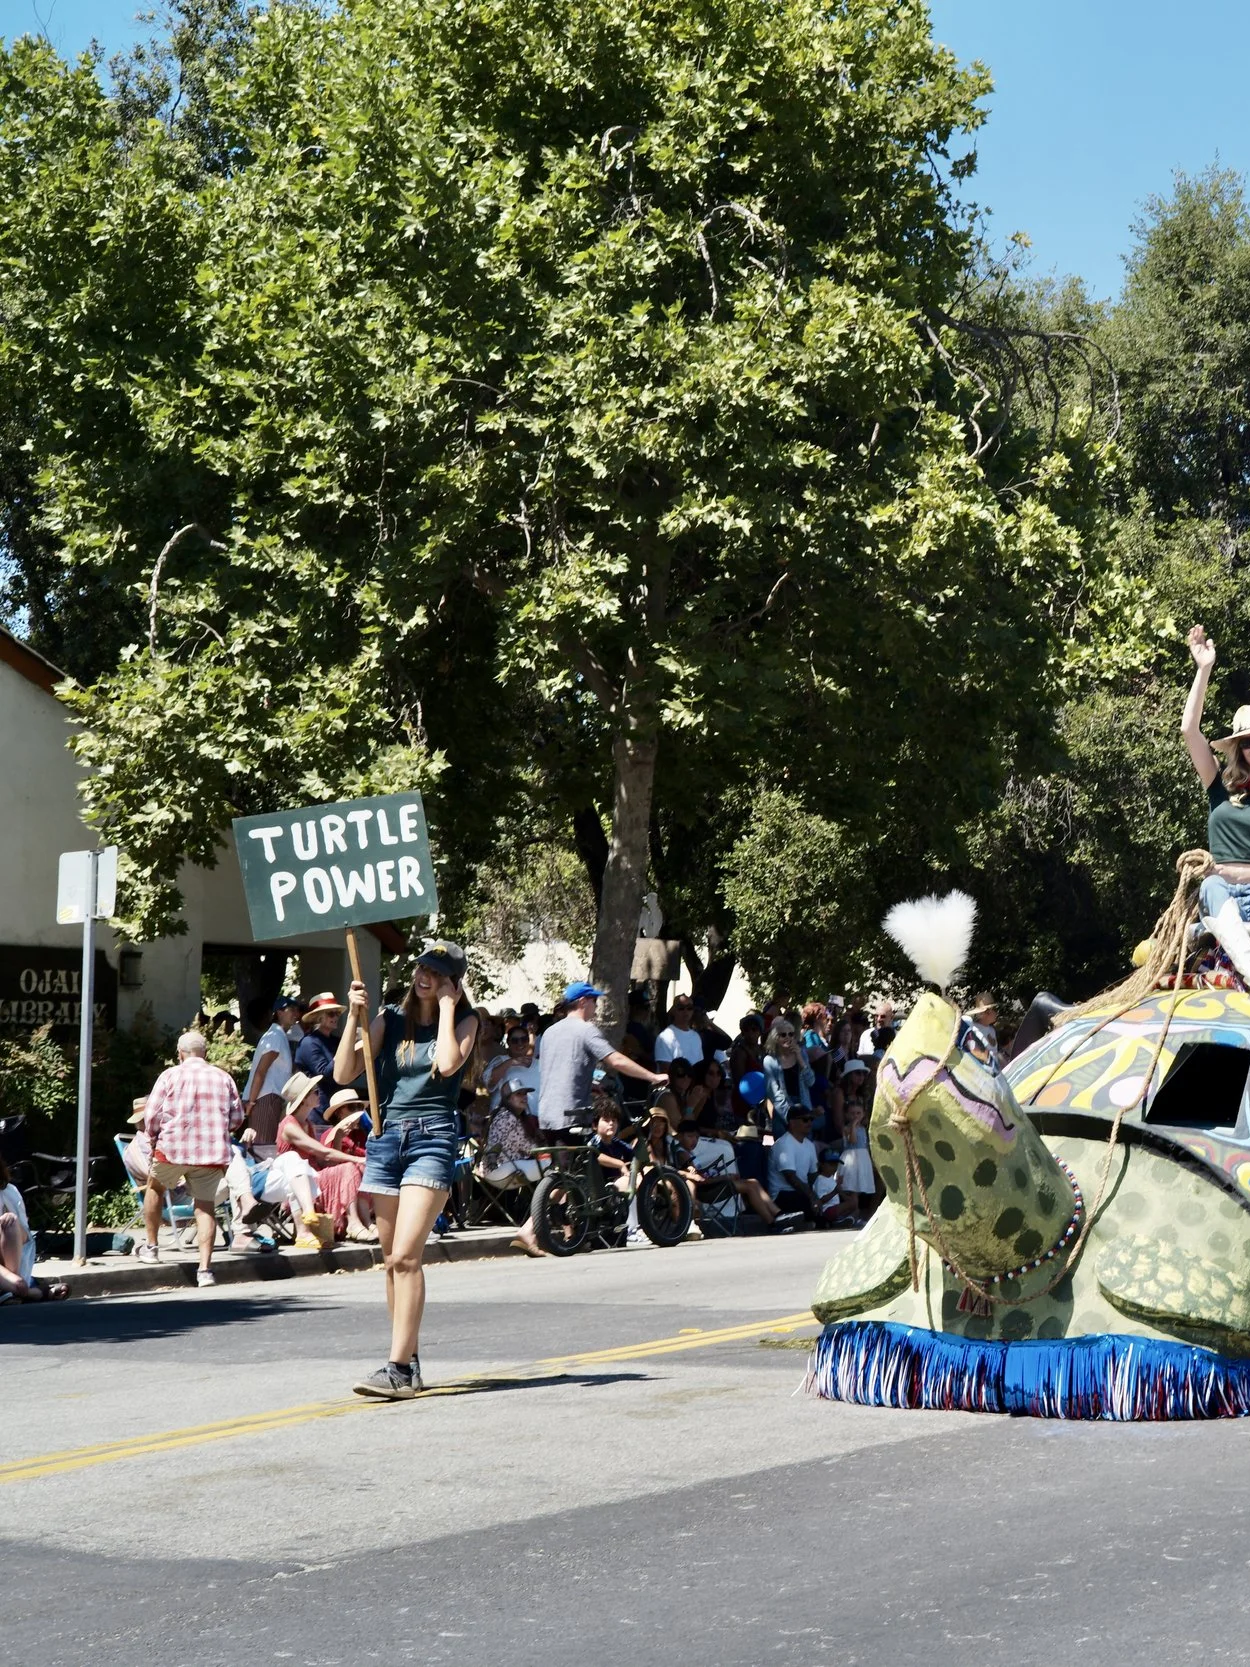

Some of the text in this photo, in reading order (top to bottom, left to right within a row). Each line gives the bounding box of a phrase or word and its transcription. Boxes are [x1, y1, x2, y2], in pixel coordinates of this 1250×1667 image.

[249, 803, 418, 863] TURTLE
[270, 856, 424, 922] POWER
[20, 968, 80, 995] OJAI
